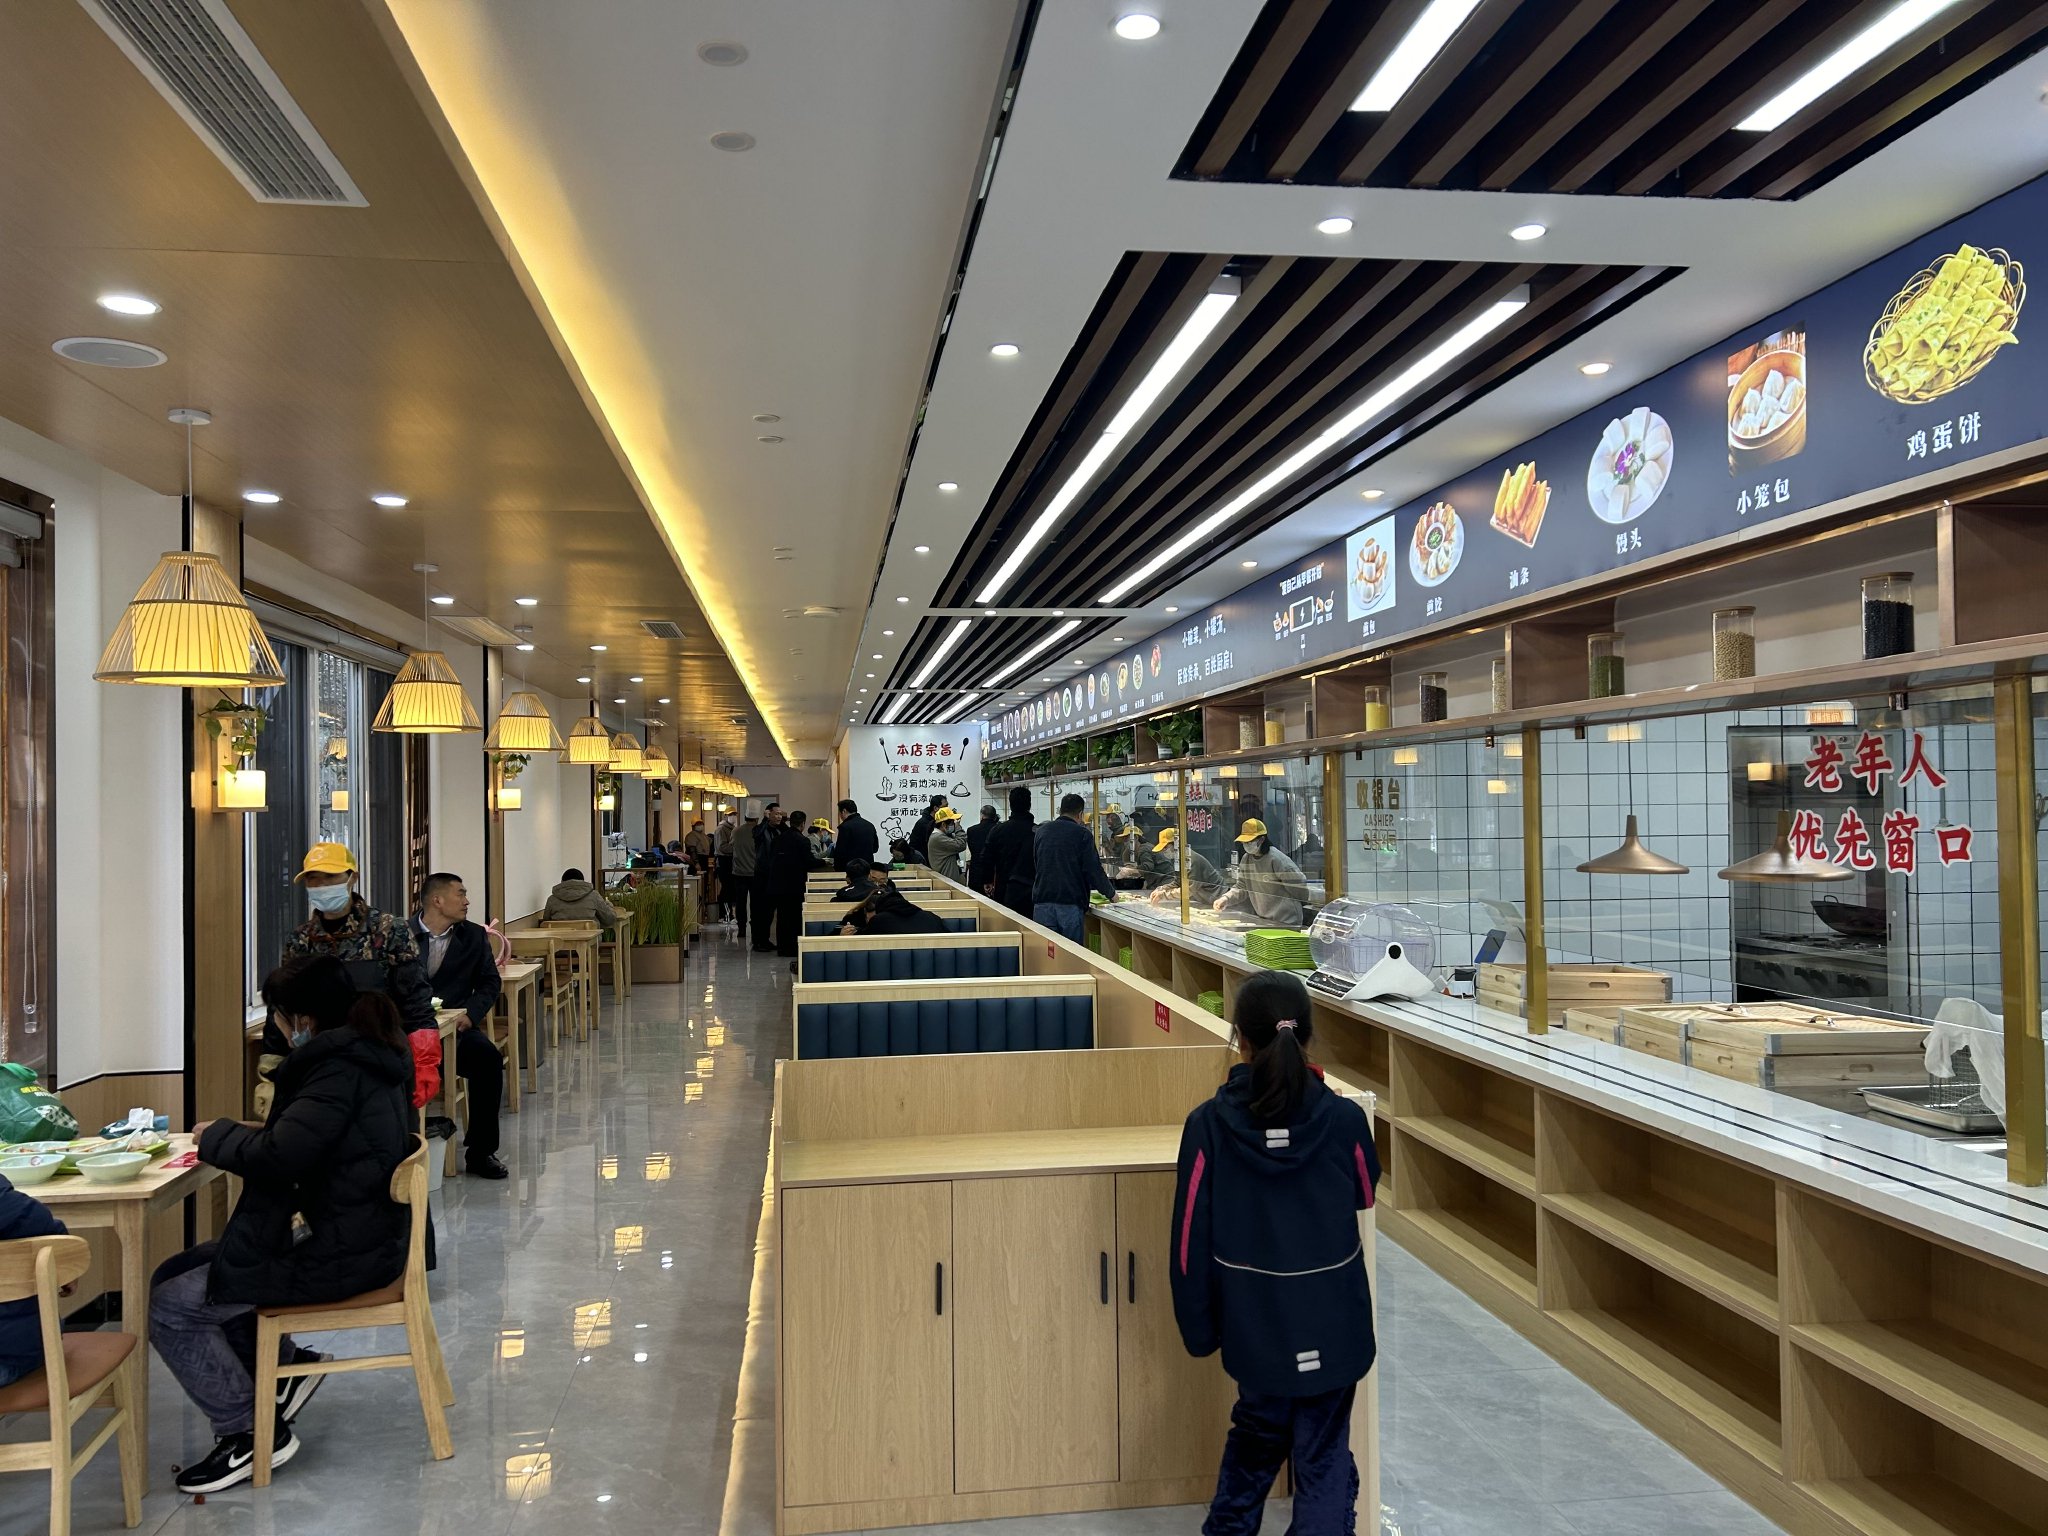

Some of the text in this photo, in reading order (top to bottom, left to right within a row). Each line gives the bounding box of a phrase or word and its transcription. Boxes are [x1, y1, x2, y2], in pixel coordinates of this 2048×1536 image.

[1906, 411, 1982, 460] 鸡蛋饼
[1736, 478, 1791, 515] 小笼包
[1616, 527, 1642, 554] 馒头
[1509, 567, 1530, 589] 油条
[896, 743, 952, 756] 本店宗旨
[890, 763, 956, 773] 不便宜 不暴利
[1804, 731, 1947, 796] 老年人
[899, 779, 948, 788] 没有地沟油
[1356, 777, 1400, 810] 收银台
[1364, 814, 1394, 826] CASHIER
[1787, 806, 1974, 876] 优先窗口
